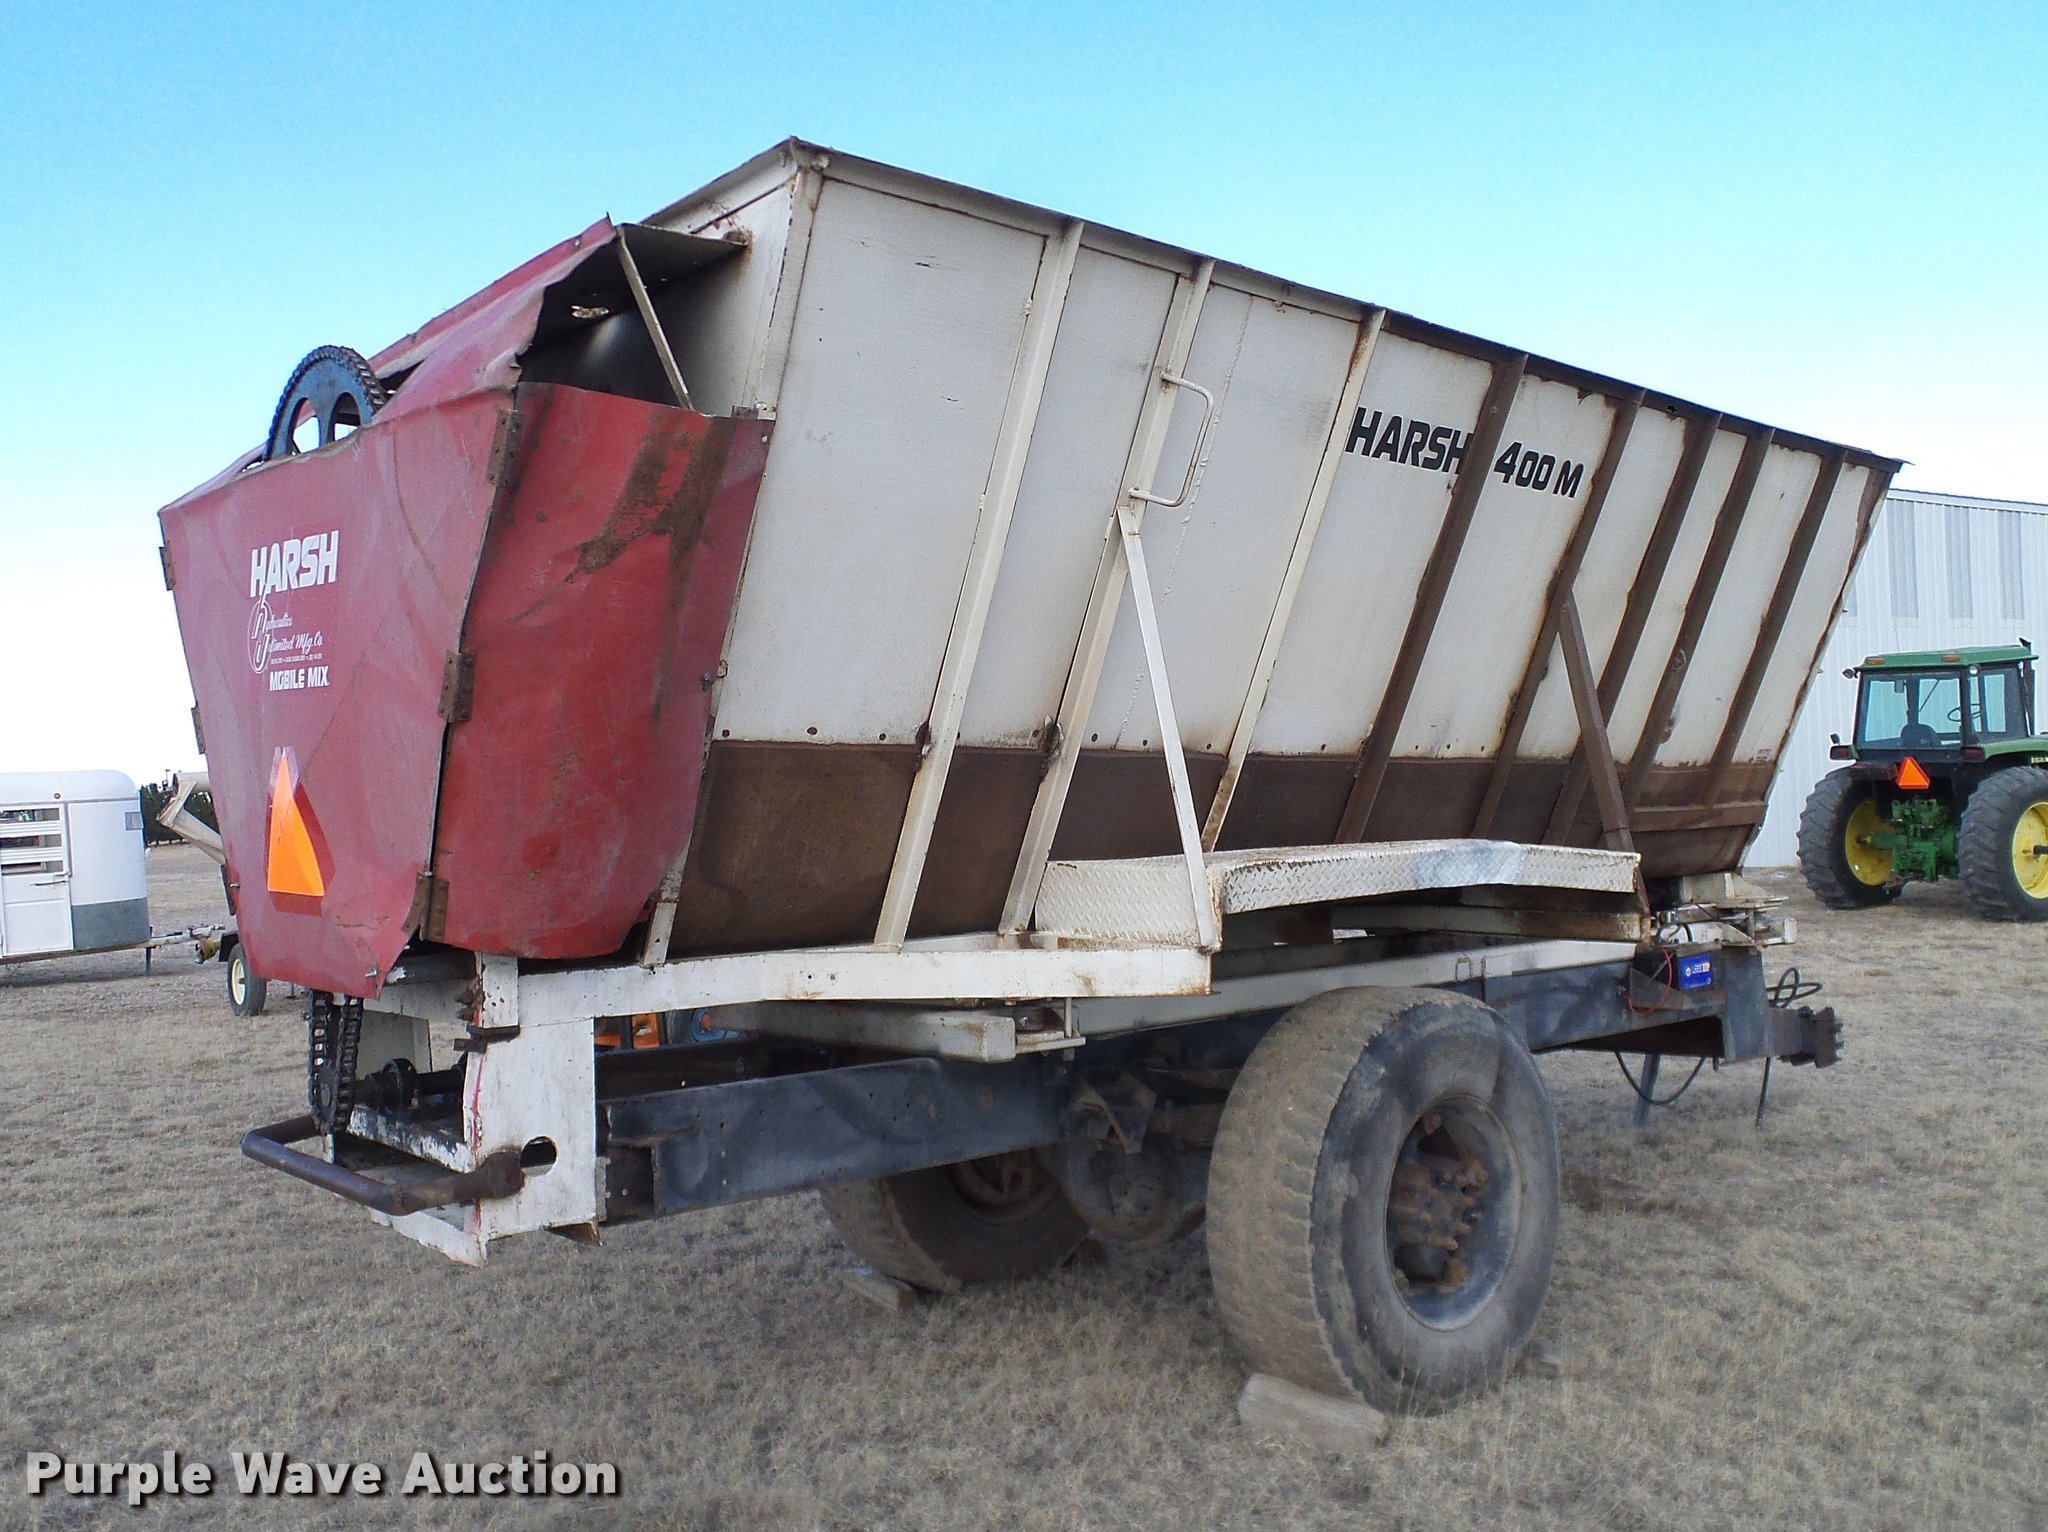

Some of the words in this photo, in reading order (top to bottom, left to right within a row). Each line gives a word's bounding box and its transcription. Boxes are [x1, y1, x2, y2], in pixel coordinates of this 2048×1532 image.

[1345, 406, 1475, 475] HARSH
[250, 530, 339, 598] HARSH
[270, 669, 305, 691] MOBILE
[307, 666, 328, 687] MIX
